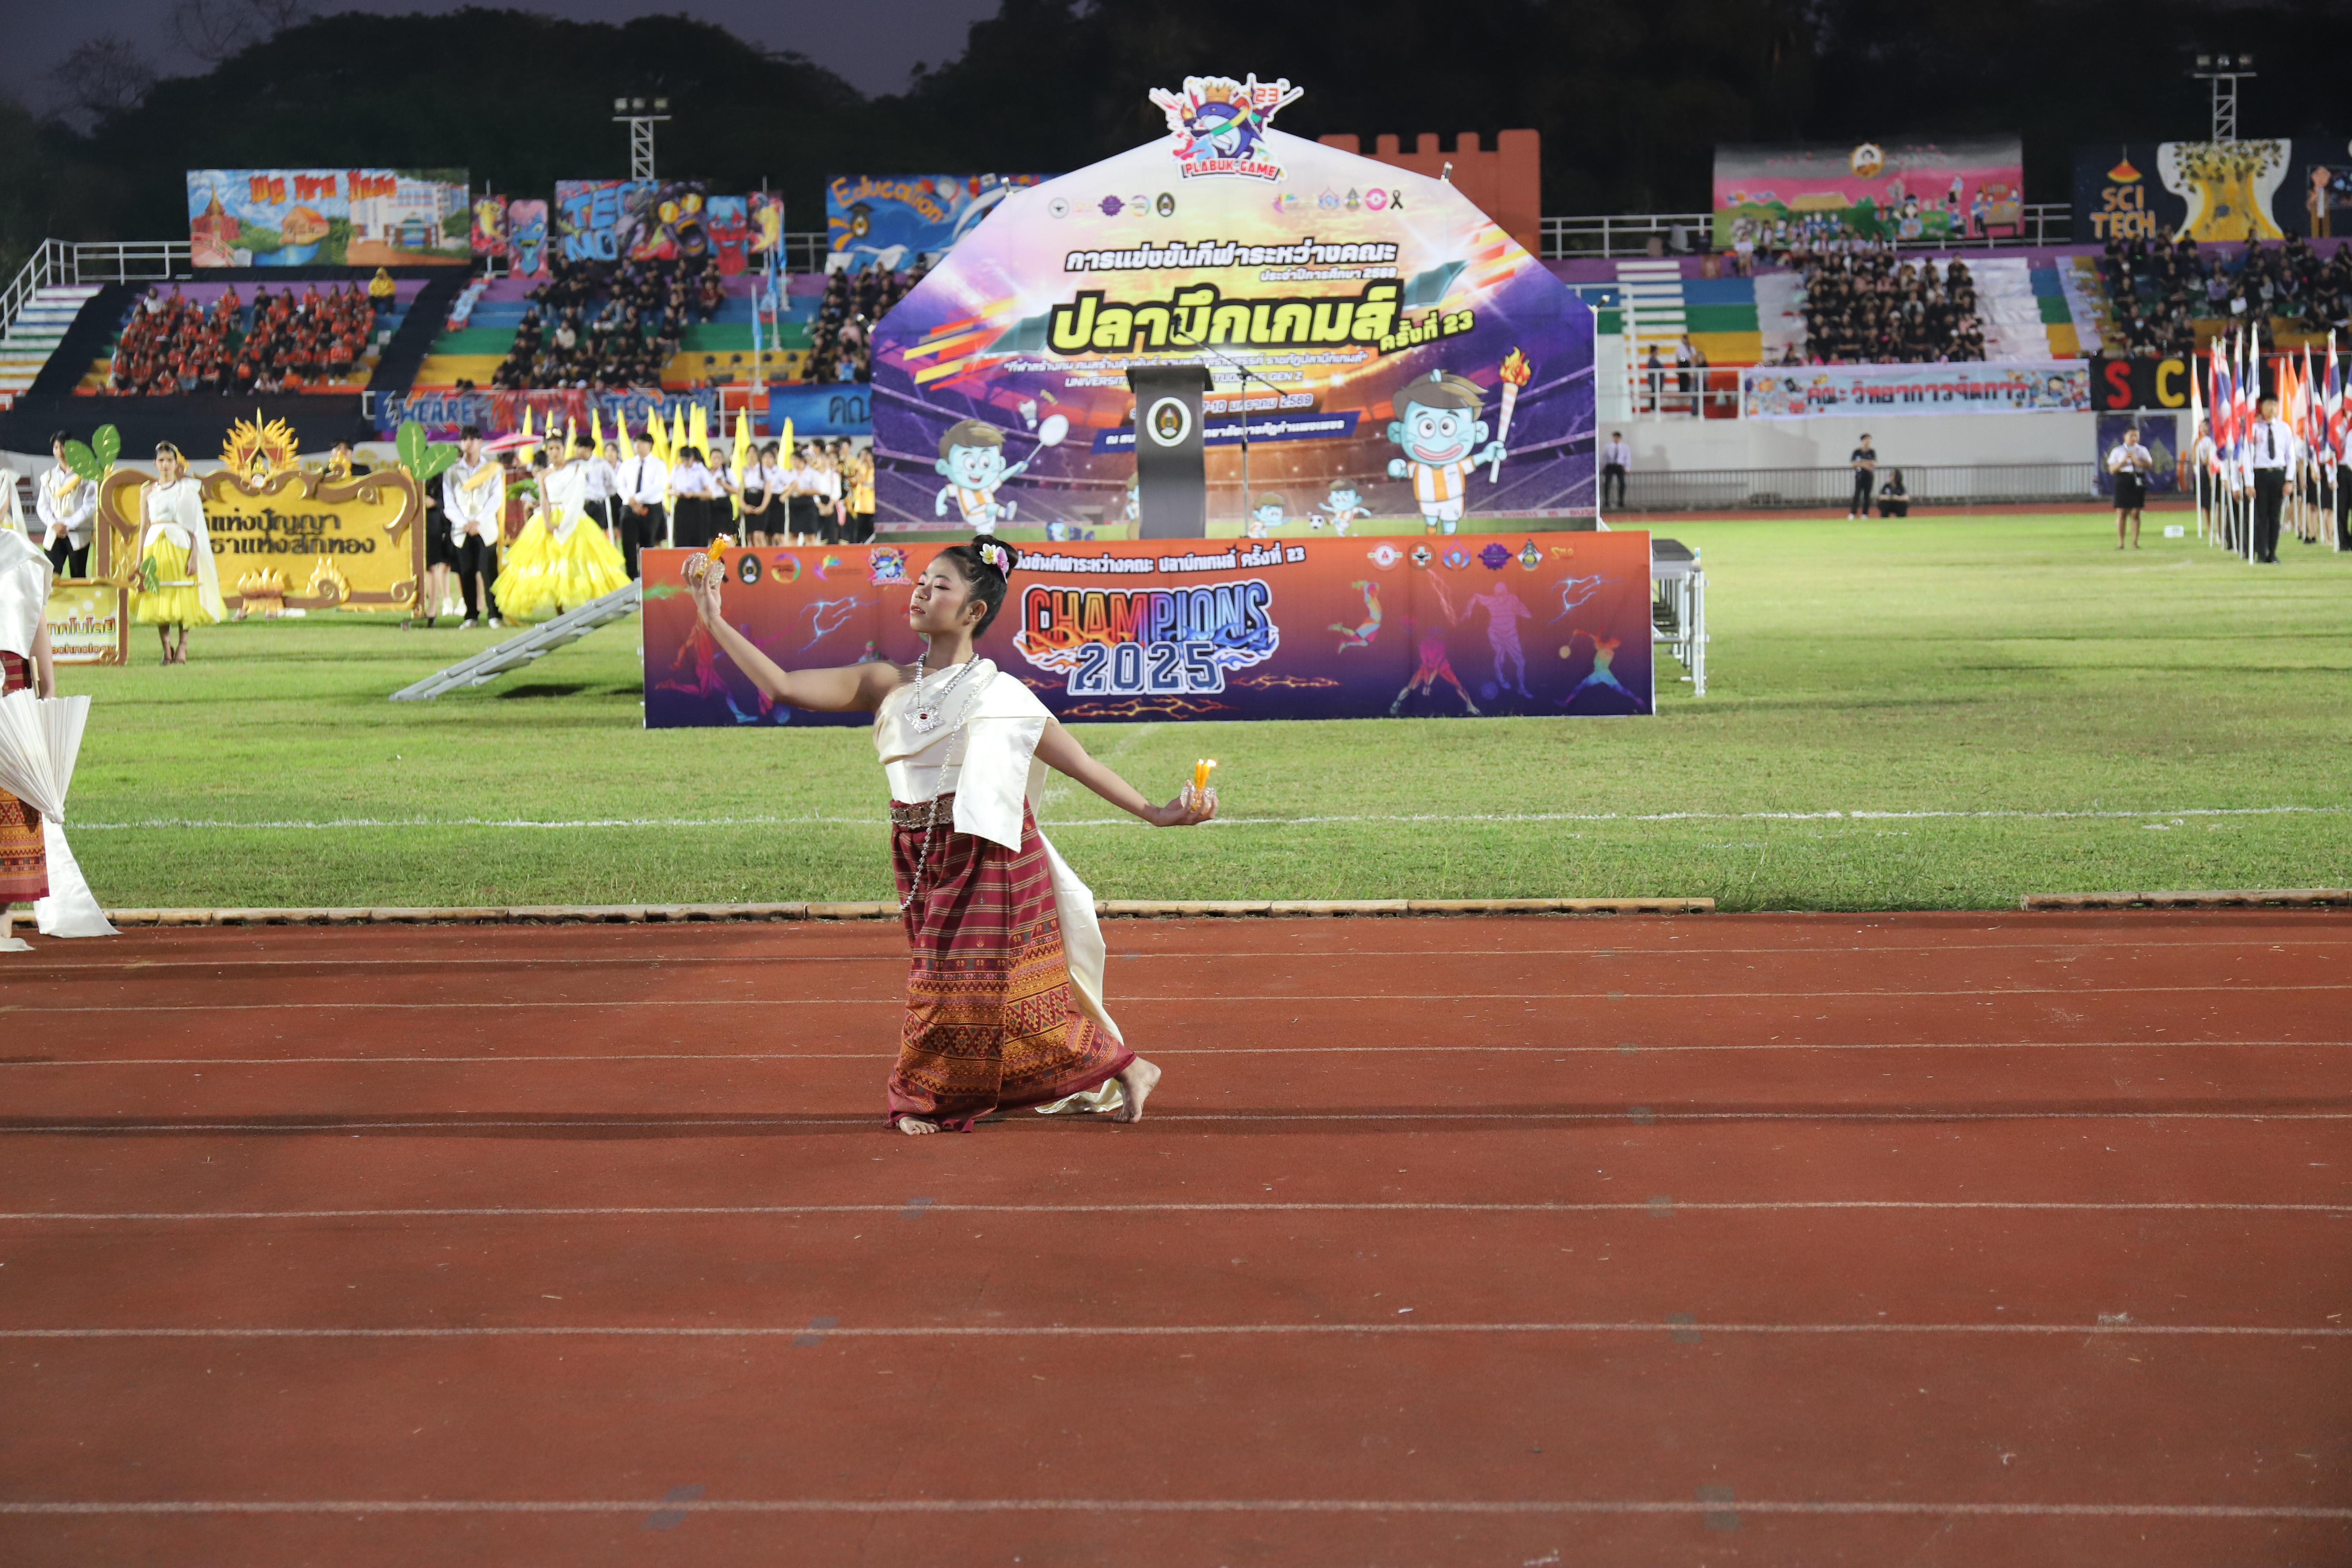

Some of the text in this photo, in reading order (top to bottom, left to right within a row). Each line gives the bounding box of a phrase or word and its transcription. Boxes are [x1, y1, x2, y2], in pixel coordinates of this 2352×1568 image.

[1254, 87, 1278, 103] 23
[1185, 160, 1276, 176] PLABUK GAME
[2102, 185, 2144, 211] SCI
[2090, 210, 2156, 239] TECH
[565, 227, 618, 262] NO
[1065, 237, 1398, 272] การแข่งขันกีฬาระหว่างคณะ
[1260, 268, 1362, 281] ประจำปีการศึกษา
[1378, 310, 1475, 354] ครั้งที่ 23
[1807, 375, 2030, 404] คณะ วิทยาการจัดการ
[1240, 541, 1283, 568] ครั้งที่
[1285, 546, 1306, 563] 23
[1025, 582, 1269, 649] CHAMPIONS
[1070, 641, 1222, 694] 2025
